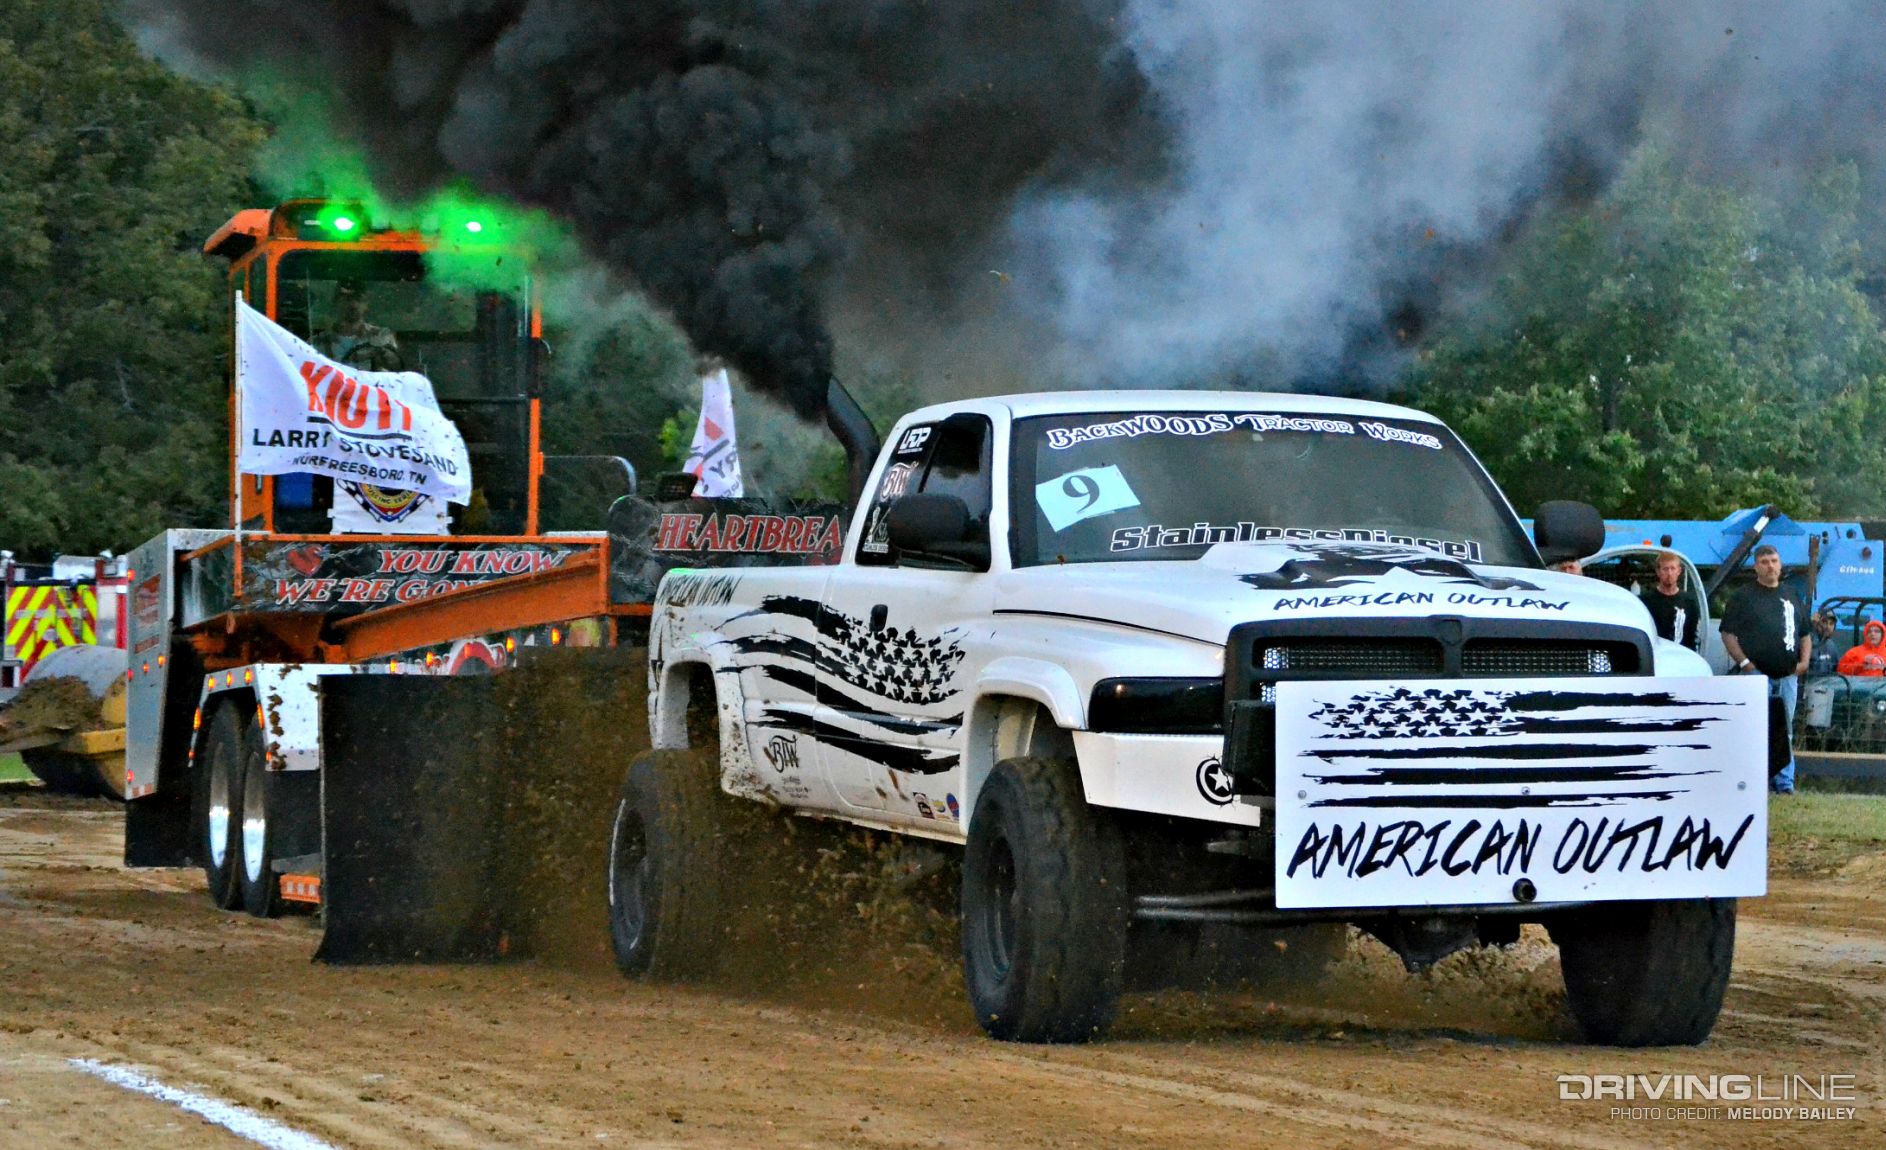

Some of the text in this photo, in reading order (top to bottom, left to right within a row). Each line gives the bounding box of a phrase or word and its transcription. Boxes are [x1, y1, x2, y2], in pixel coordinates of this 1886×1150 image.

[1047, 414, 1443, 450] BACKWOODS TRACTOR WORKS
[252, 428, 457, 477] LARRY STOVESAND
[408, 471, 427, 485] TN
[1062, 474, 1100, 514] 9
[652, 512, 843, 553] HEARTBREA
[376, 550, 570, 574] YOU KNOW
[1274, 592, 1570, 611] AMERICAN OUTLAW
[1286, 814, 1755, 879] AMERICAN OUTLAW
